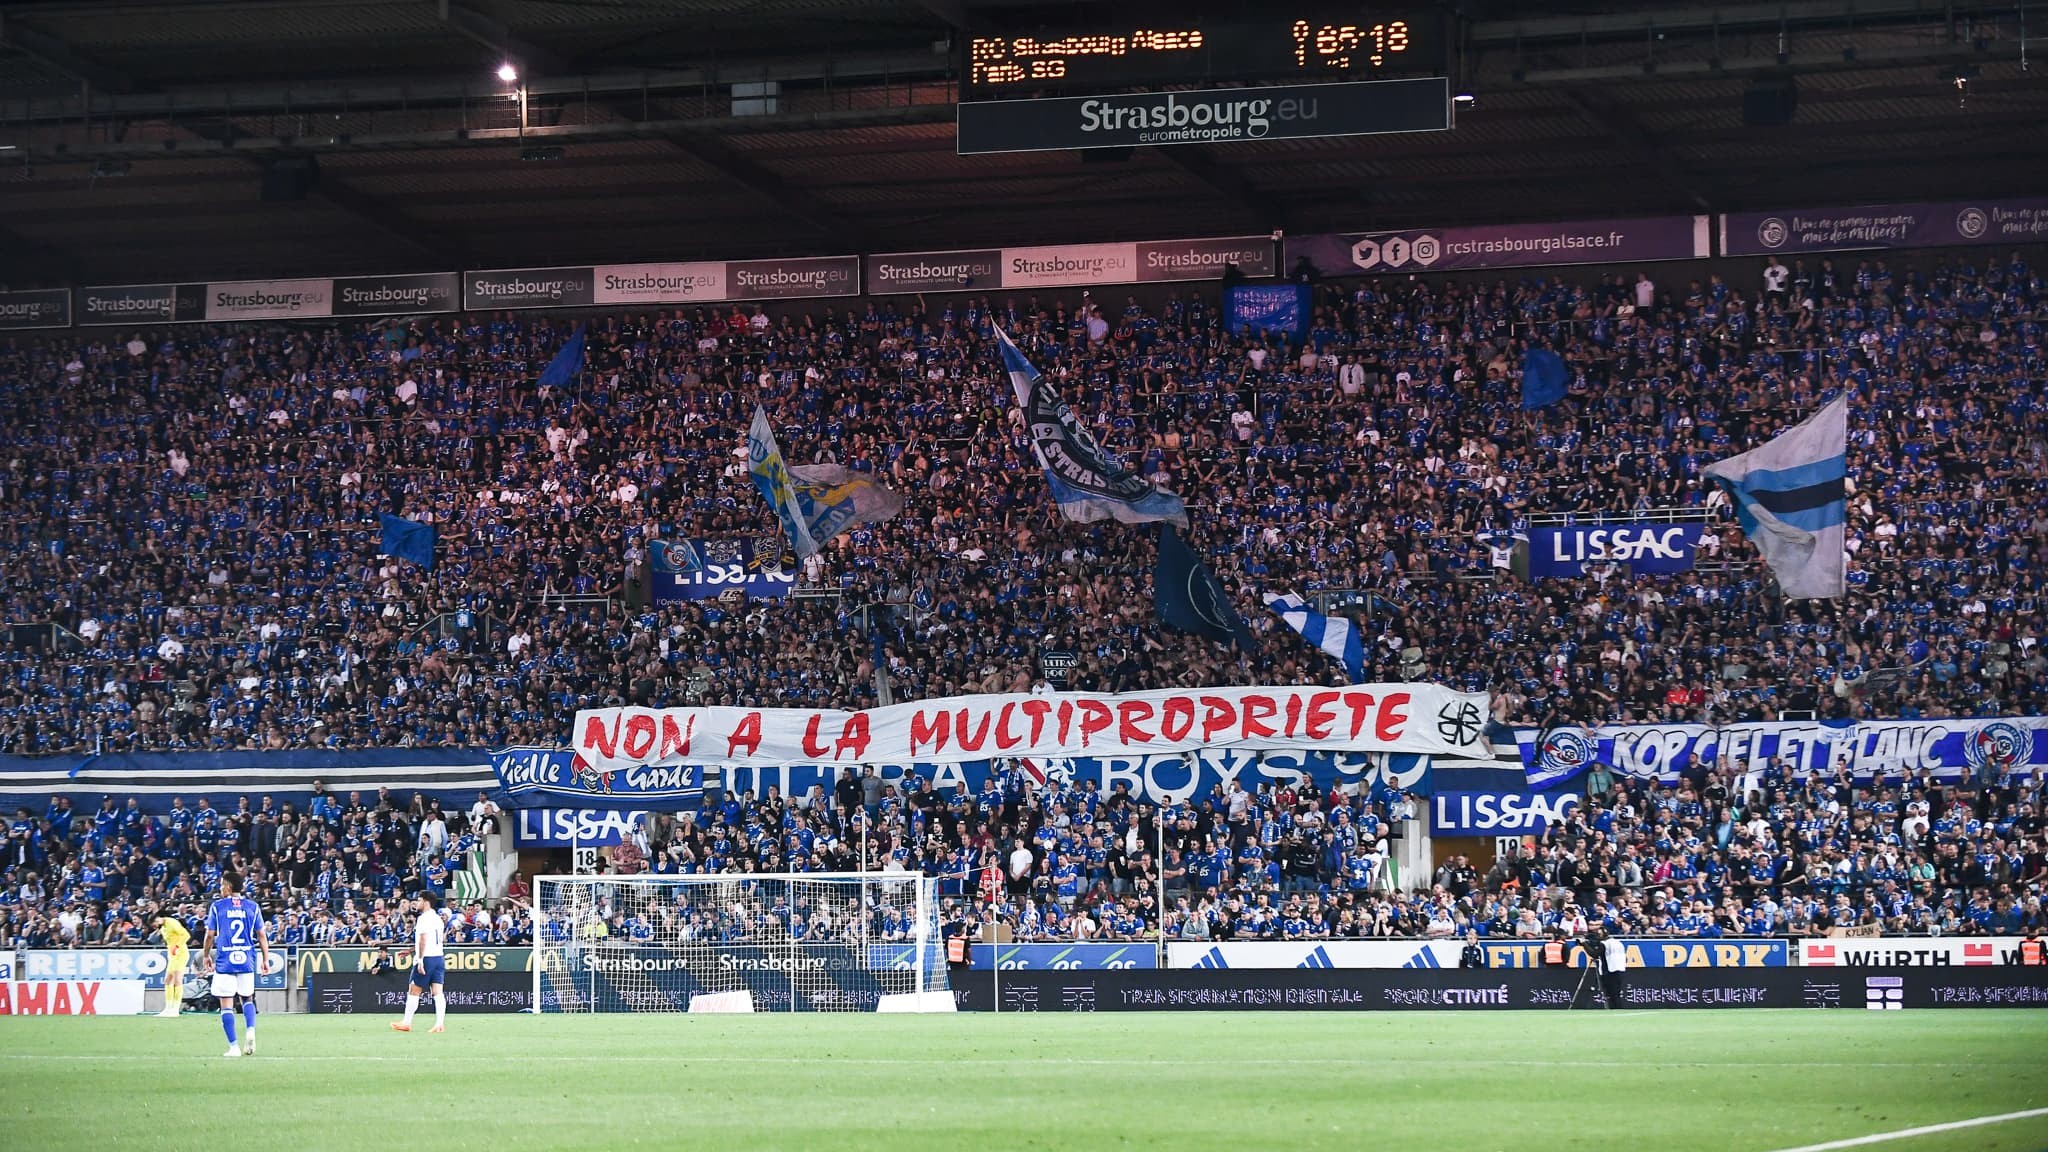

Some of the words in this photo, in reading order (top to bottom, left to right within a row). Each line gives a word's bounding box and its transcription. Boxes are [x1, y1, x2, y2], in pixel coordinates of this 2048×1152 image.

[1013, 37, 1127, 57] Strasbourg
[1131, 29, 1202, 50] Alsace
[972, 61, 1026, 84] Paris
[1031, 59, 1067, 79] SG
[1079, 95, 1318, 138] Strasbourg.eu
[1139, 126, 1242, 143] eurométropole
[1446, 231, 1624, 255] rcstrasbourgalsace.fr
[1012, 255, 1126, 277] Strasbourg.eu
[1147, 249, 1263, 268] Strasbourg.eu
[604, 273, 716, 295] Strasbourg.eu
[736, 268, 848, 290] Strasbourg.eu
[879, 261, 992, 284] Strasbourg.eu
[343, 285, 450, 306] Strasbourg.eu
[474, 278, 584, 300] Strasbourg.eu
[1552, 527, 1685, 562] LISSAC
[583, 712, 696, 760] NON
[727, 711, 762, 759] A
[801, 711, 872, 762] LA
[910, 690, 1412, 758] MULTIPROPRIETE
[1611, 728, 1688, 776] KOP
[1778, 727, 1819, 775] ET
[1826, 725, 1949, 774] BLANC
[625, 763, 694, 791] Garde
[1091, 752, 1307, 806] BOYS
[1436, 793, 1580, 830] LISSAC
[576, 850, 595, 867] 18
[230, 919, 246, 945] 2
[1661, 944, 1772, 968] PARK
